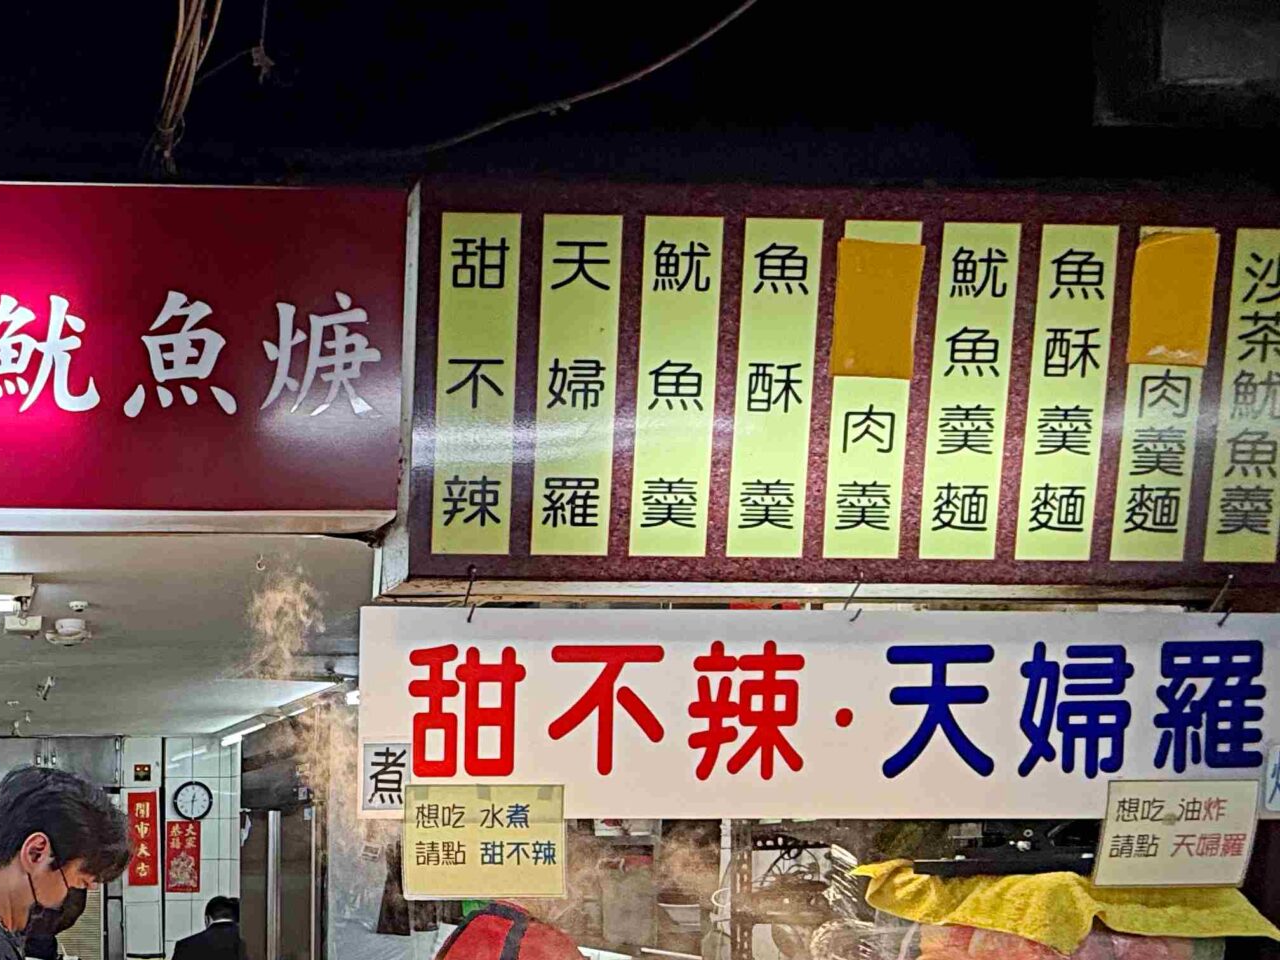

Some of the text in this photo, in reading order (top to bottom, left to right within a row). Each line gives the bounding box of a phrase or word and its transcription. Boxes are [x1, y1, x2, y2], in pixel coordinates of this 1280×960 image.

[442, 236, 510, 530] 甜不辣
[540, 239, 612, 530] 天婦羅
[640, 239, 712, 531] 魷魚羹
[738, 241, 810, 532] 魚酥羹
[930, 247, 1008, 533] 魷魚羹麵
[1028, 247, 1106, 534] 魚酥羹麵
[1124, 368, 1194, 535] 肉羹麵
[134, 802, 151, 877] 開市大吉
[368, 747, 407, 804] 煮
[415, 841, 556, 866] 請點 甜不辣
[416, 803, 530, 829] 想吃 水煮
[1109, 833, 1247, 858] 請點 天婦羅
[1116, 796, 1228, 822] 想吃 油炸
